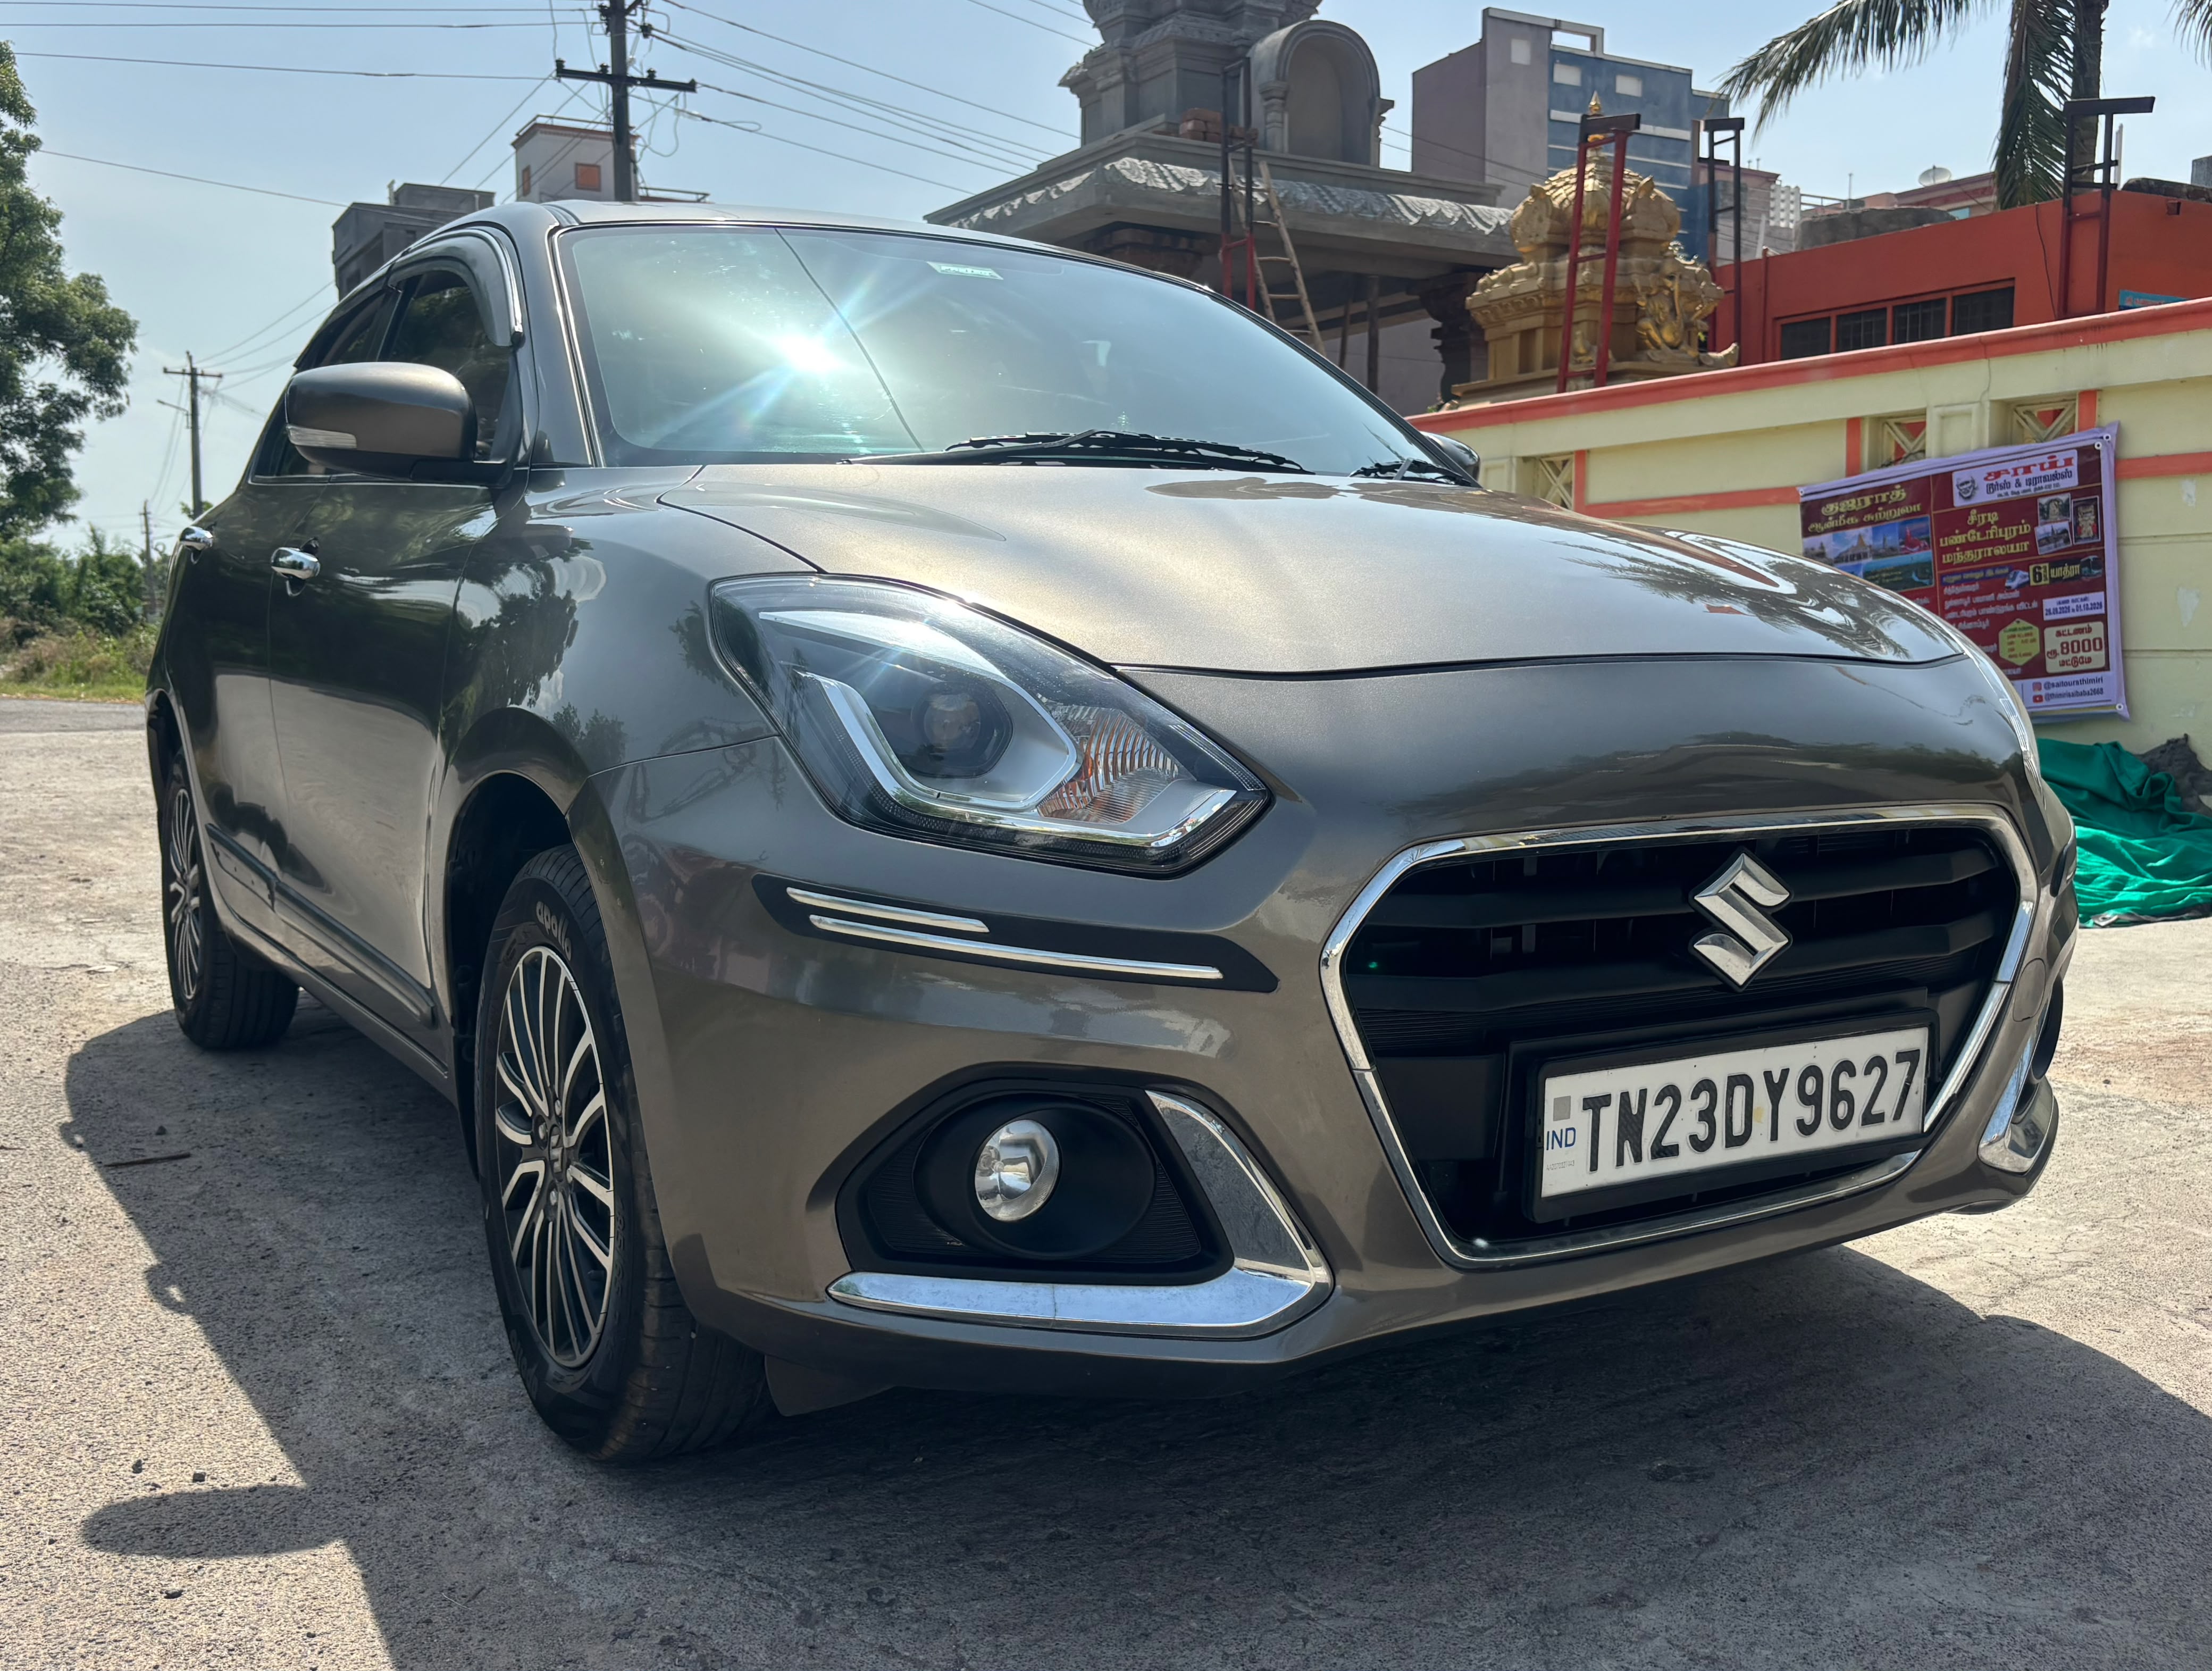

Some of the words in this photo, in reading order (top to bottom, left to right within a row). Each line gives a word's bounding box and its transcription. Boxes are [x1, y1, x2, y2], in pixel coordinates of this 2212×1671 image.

[1983, 455, 2074, 482] சாய்
[2026, 469, 2073, 487] டிராவல்ஸ்
[1821, 484, 1907, 516] குஜராத்
[1808, 514, 1859, 532] ஆன்மீக
[1863, 503, 1922, 522] சுற்றுலா
[1967, 509, 1999, 527] சீரடி
[2032, 565, 2042, 583] 6
[2050, 563, 2081, 580] யாத்ரா
[2056, 624, 2092, 637] கட்டணம்
[2059, 656, 2092, 667] மட்டுமே
[535, 900, 573, 962] apollo
[1581, 1049, 1920, 1173] TN23DY9627
[1546, 1126, 1577, 1151] IND
